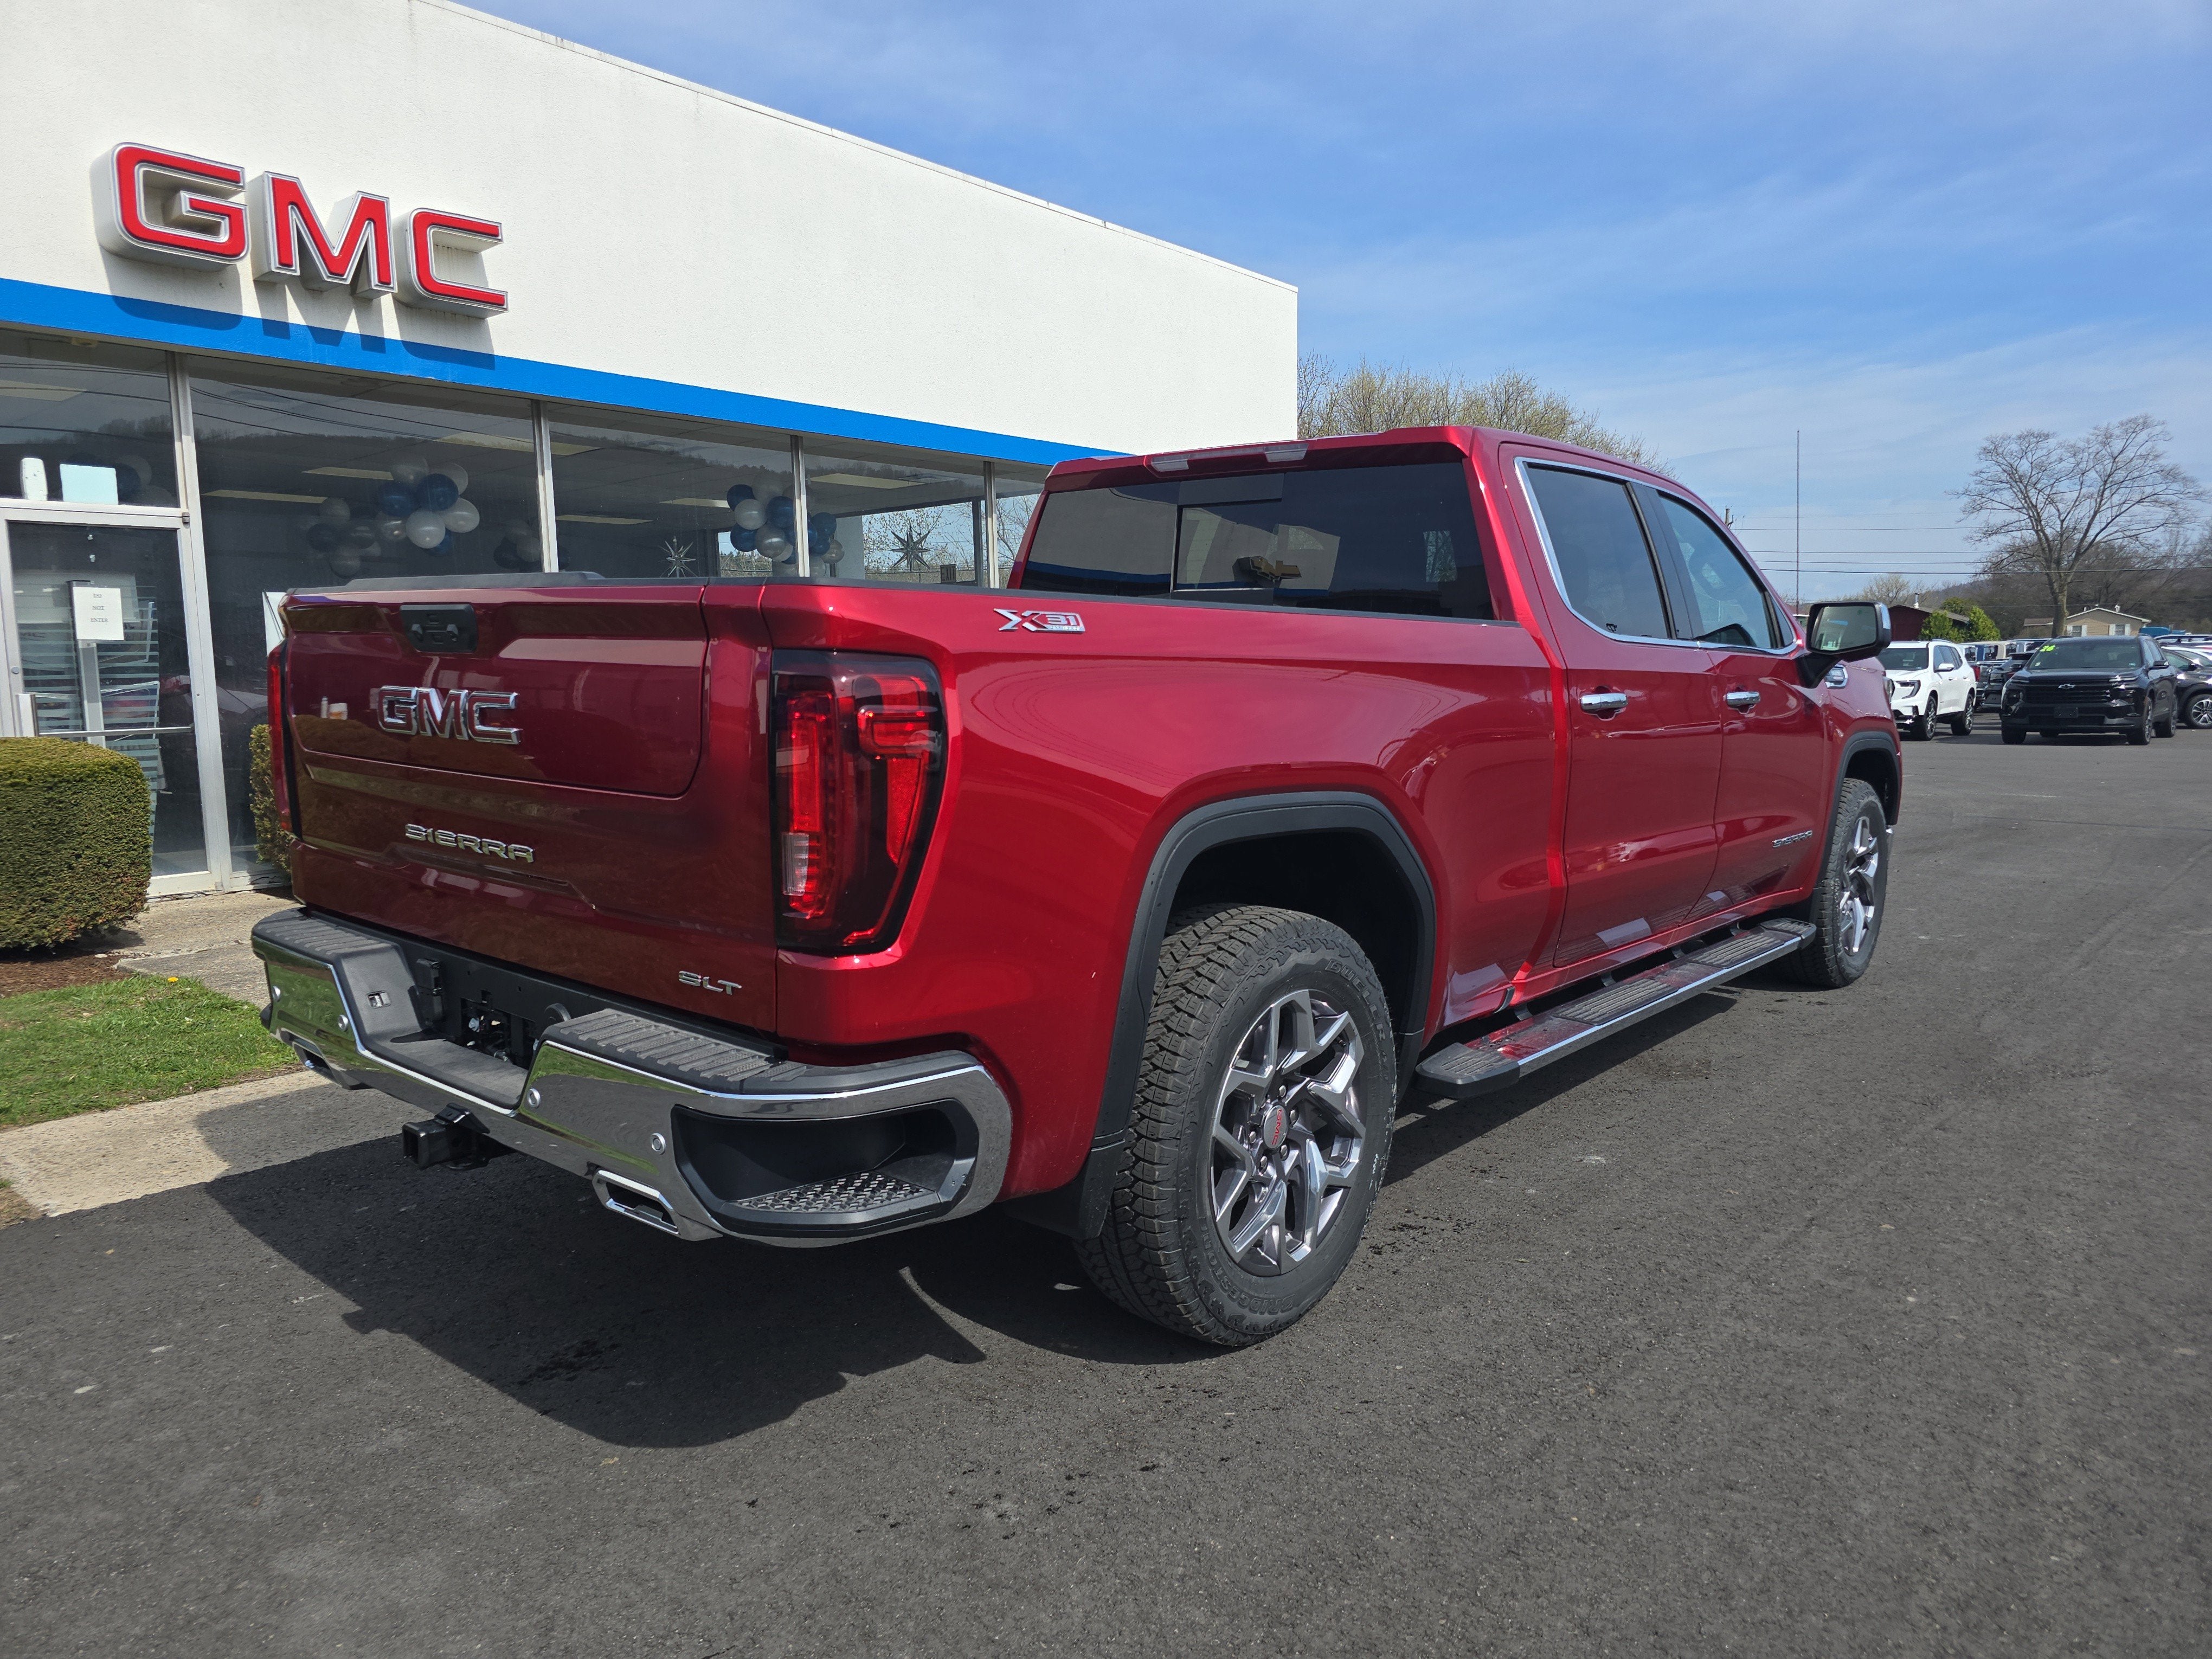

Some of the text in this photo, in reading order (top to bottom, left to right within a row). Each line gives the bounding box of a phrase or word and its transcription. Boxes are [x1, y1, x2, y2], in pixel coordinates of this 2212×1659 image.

[103, 142, 509, 315] GMC
[941, 565, 955, 581] EXIT
[993, 608, 1085, 633] X31
[377, 685, 523, 745] GMC
[404, 823, 536, 863] SIERRA
[679, 970, 742, 996] SLT
[1324, 958, 1386, 1041] DUELER
[1271, 1108, 1283, 1145] GMC
